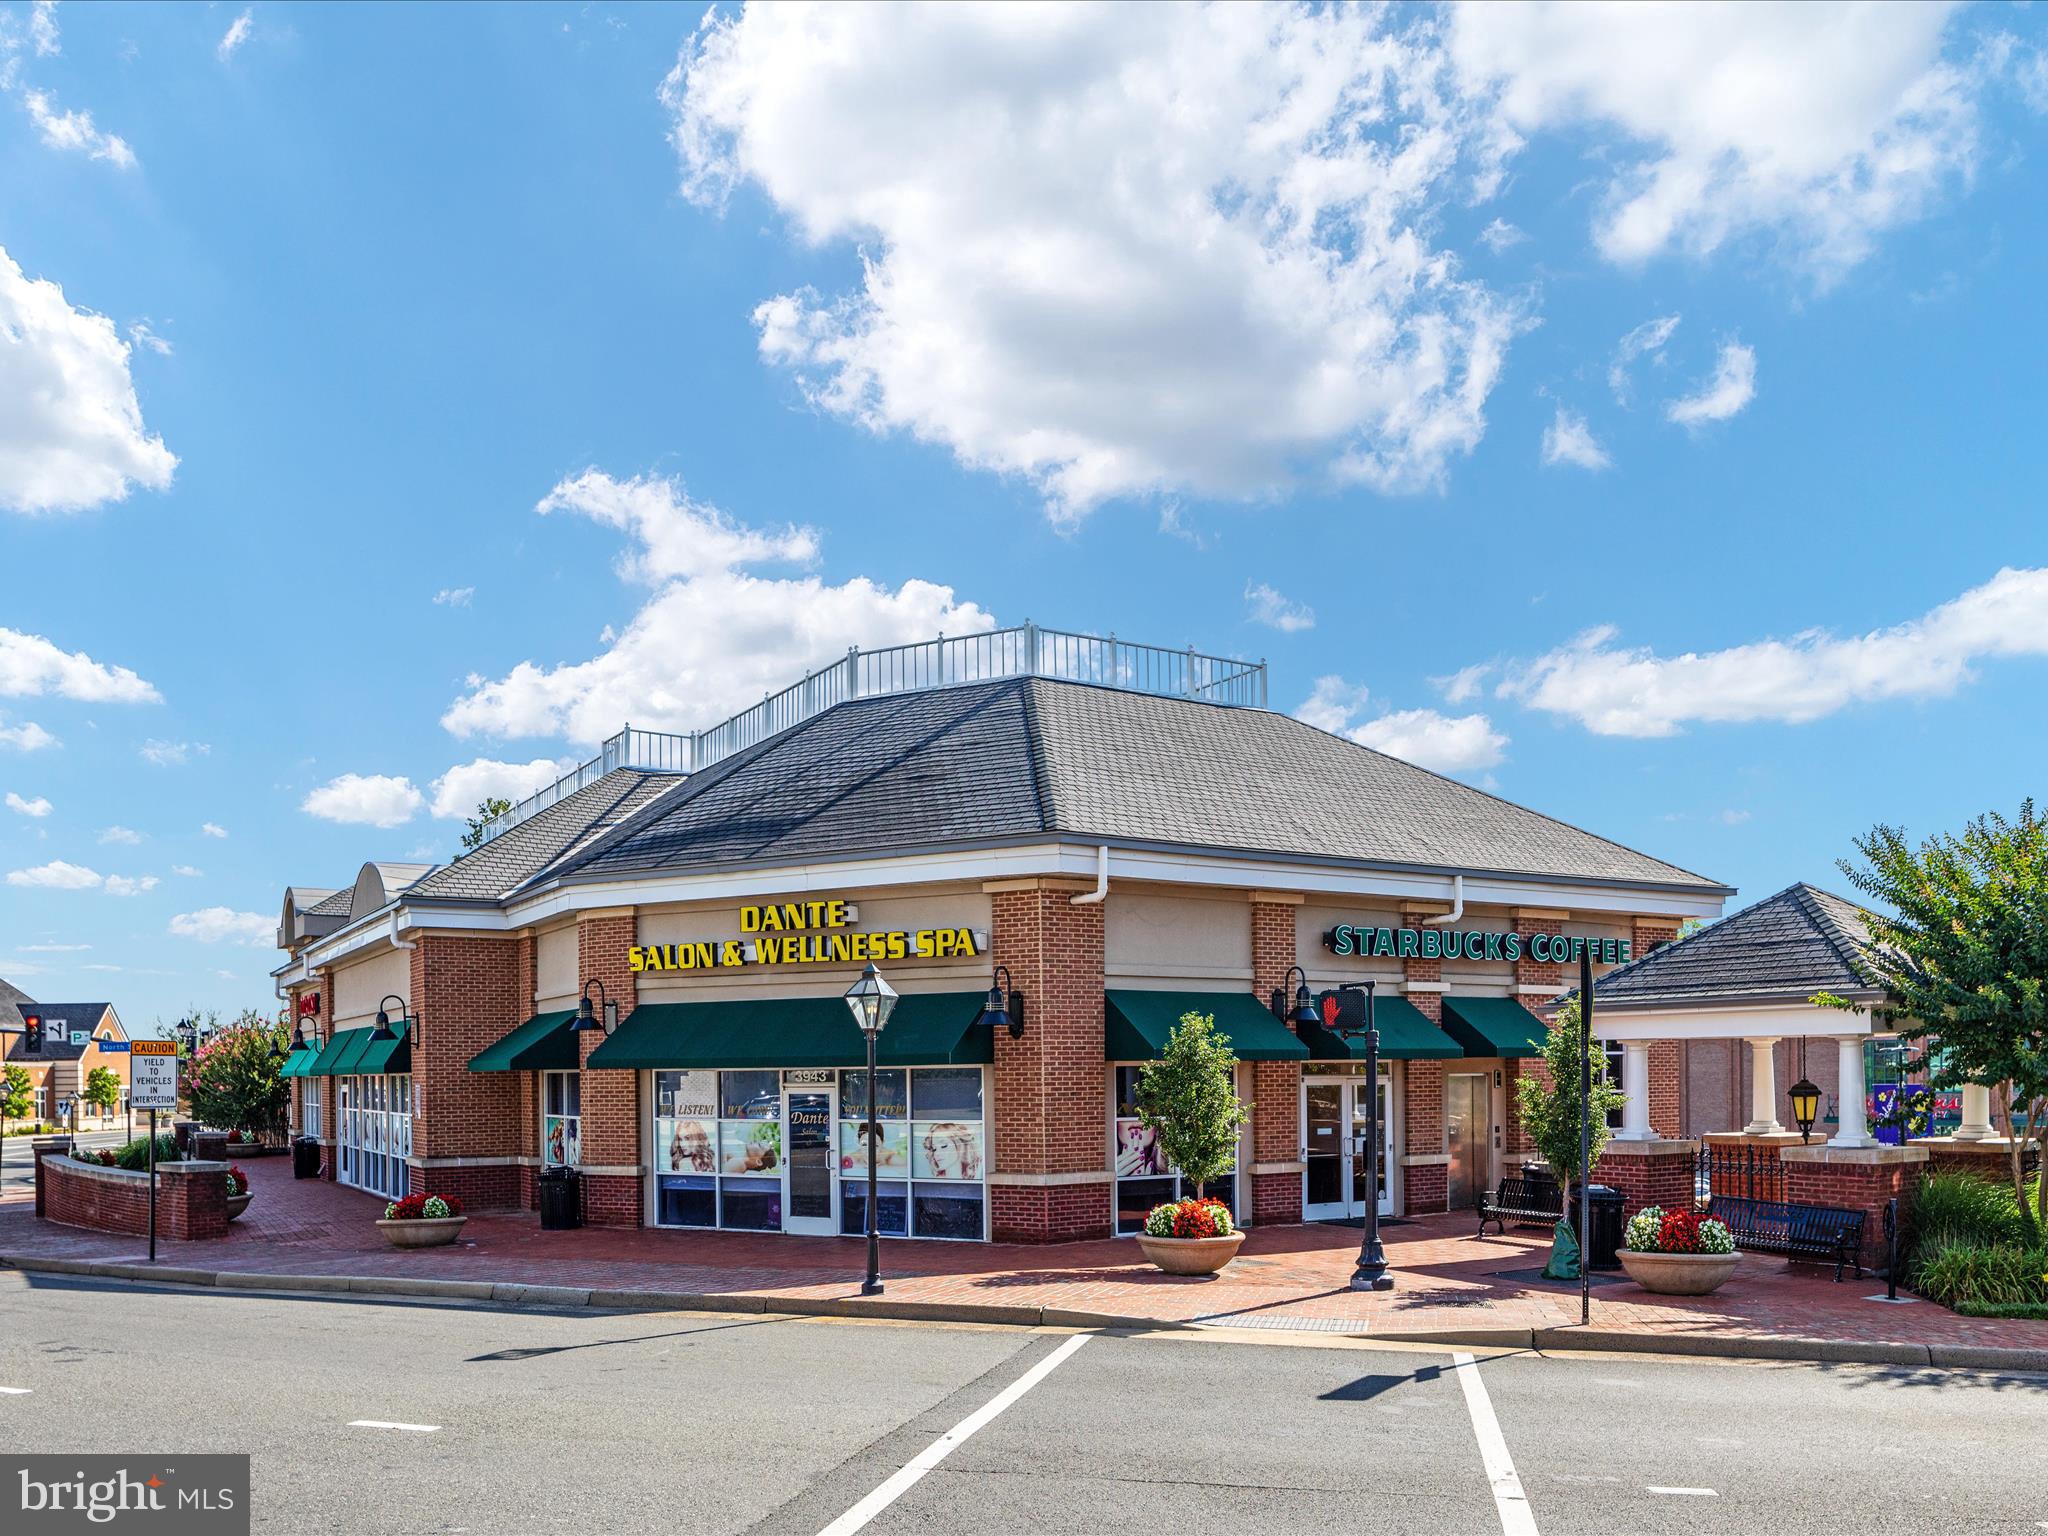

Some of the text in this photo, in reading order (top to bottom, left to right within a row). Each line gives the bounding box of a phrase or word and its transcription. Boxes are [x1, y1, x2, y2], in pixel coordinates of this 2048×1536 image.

[739, 900, 849, 933] DANTE
[628, 927, 977, 972] SALON & WELLNESS SPA
[1334, 924, 1632, 965] STARBUCKS COFFEE
[134, 1043, 175, 1053] CAUTION
[143, 1058, 165, 1066] YIELD
[150, 1067, 159, 1075] TO
[794, 1070, 827, 1082] 3943
[136, 1077, 172, 1085] VEHICLES
[150, 1086, 158, 1094] IN
[132, 1095, 175, 1103] INTERSECTION
[678, 1104, 715, 1115] LISTEN!
[791, 1111, 829, 1124] Dante
